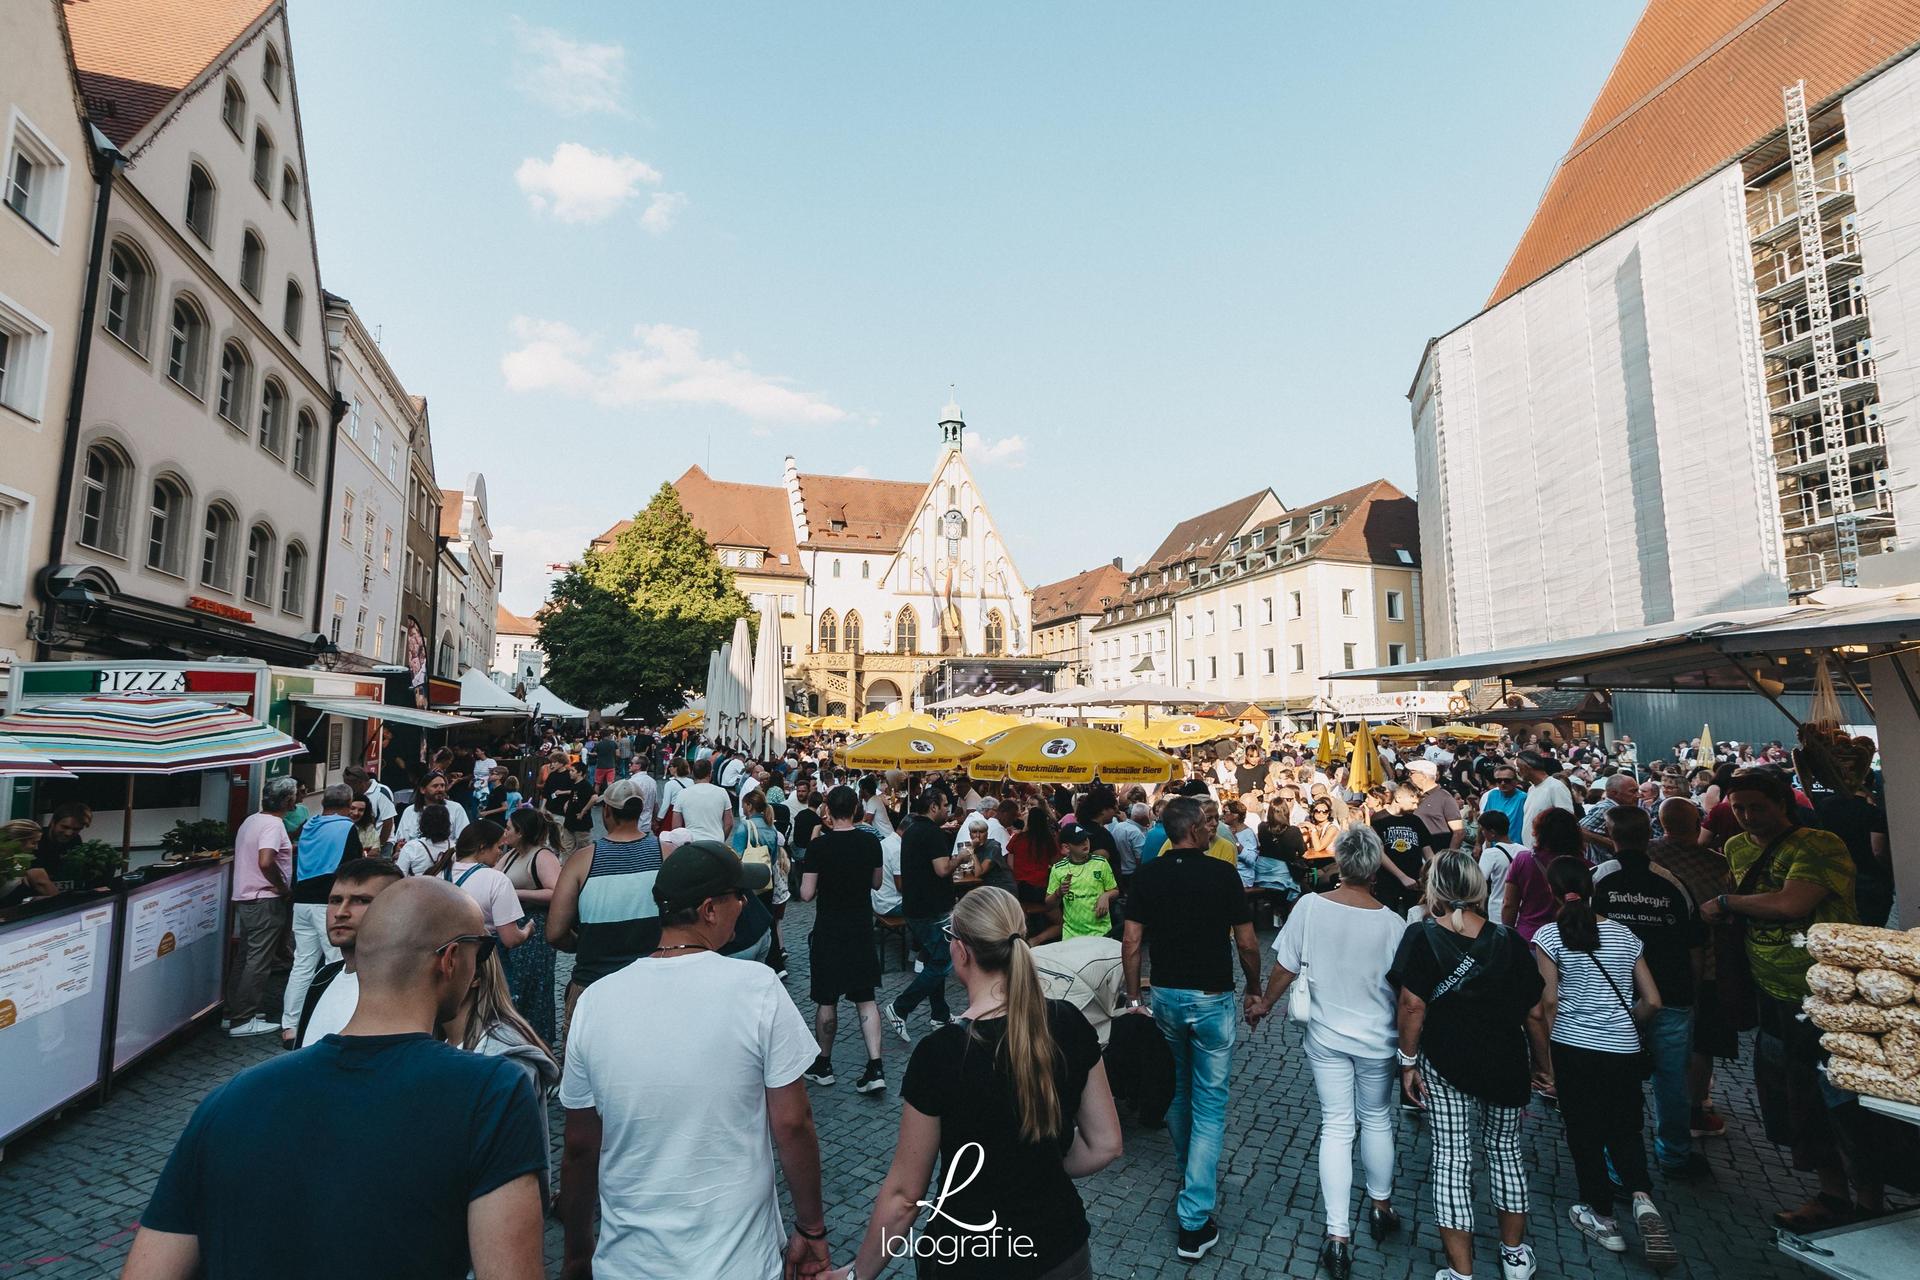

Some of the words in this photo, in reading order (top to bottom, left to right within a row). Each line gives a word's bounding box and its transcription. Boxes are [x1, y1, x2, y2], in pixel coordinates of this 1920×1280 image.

[91, 671, 192, 691] PIZZA
[1016, 763, 1065, 773] Bruckmüller
[1066, 765, 1087, 773] Biere
[1102, 766, 1141, 774] Bruckmüller
[1142, 765, 1162, 774] Biere
[1608, 891, 1671, 908] Fuchsberger
[1608, 913, 1636, 921] SIGNAL
